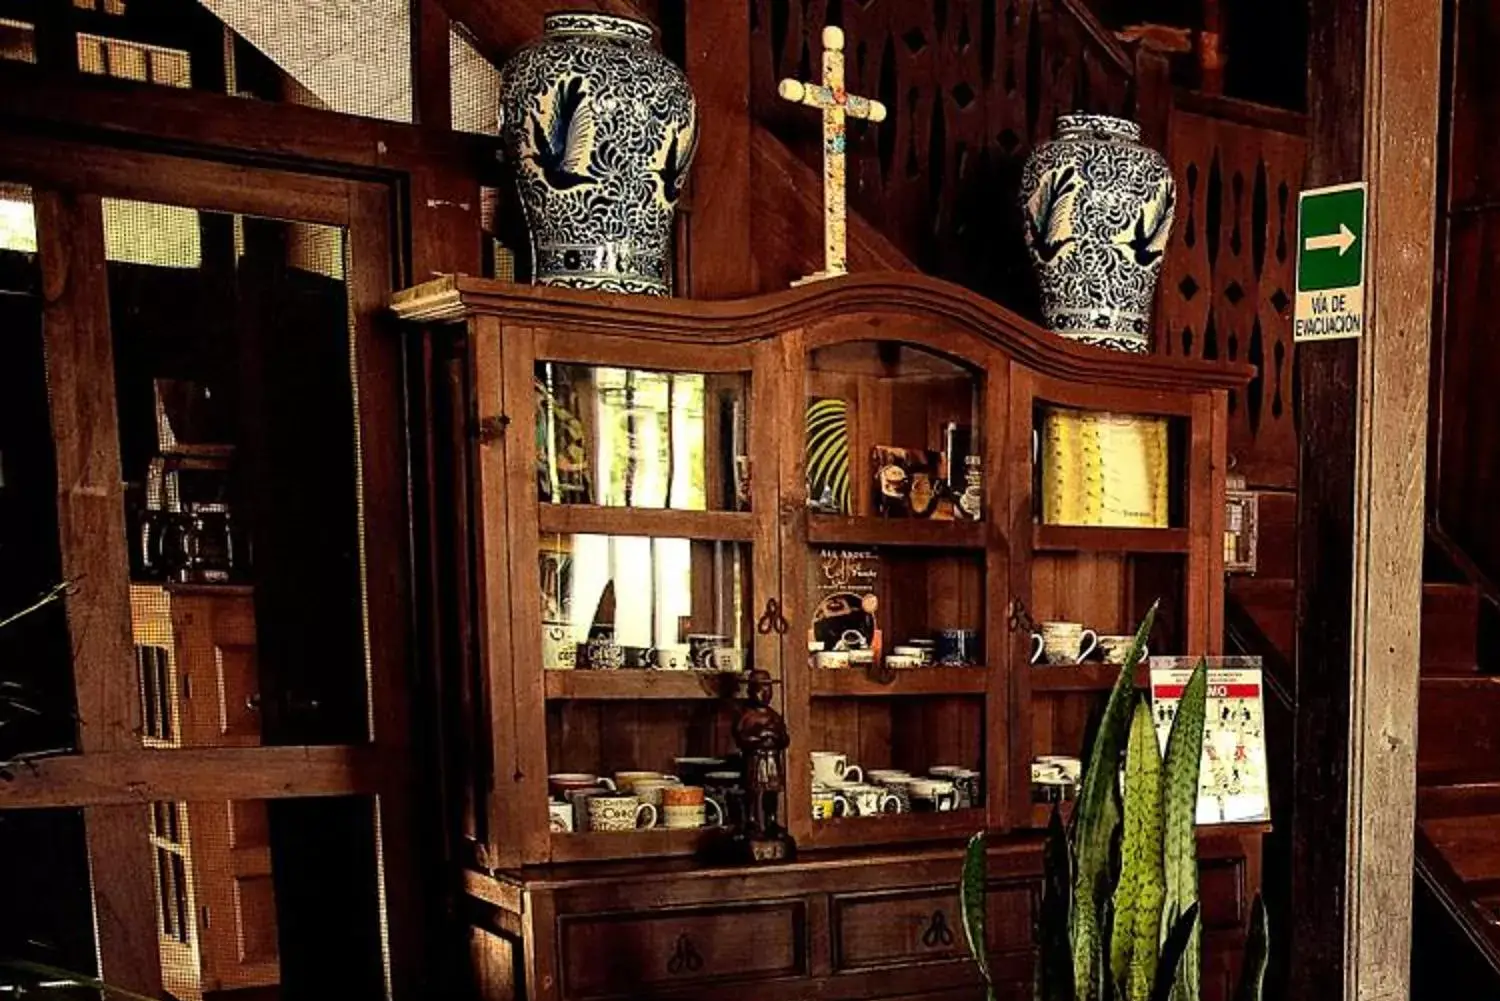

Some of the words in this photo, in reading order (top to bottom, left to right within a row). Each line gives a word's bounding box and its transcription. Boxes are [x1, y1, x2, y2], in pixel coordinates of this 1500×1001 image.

[1312, 292, 1328, 314] VÍA
[1331, 294, 1346, 312] DE
[1295, 312, 1361, 337] EVACUACIÓN
